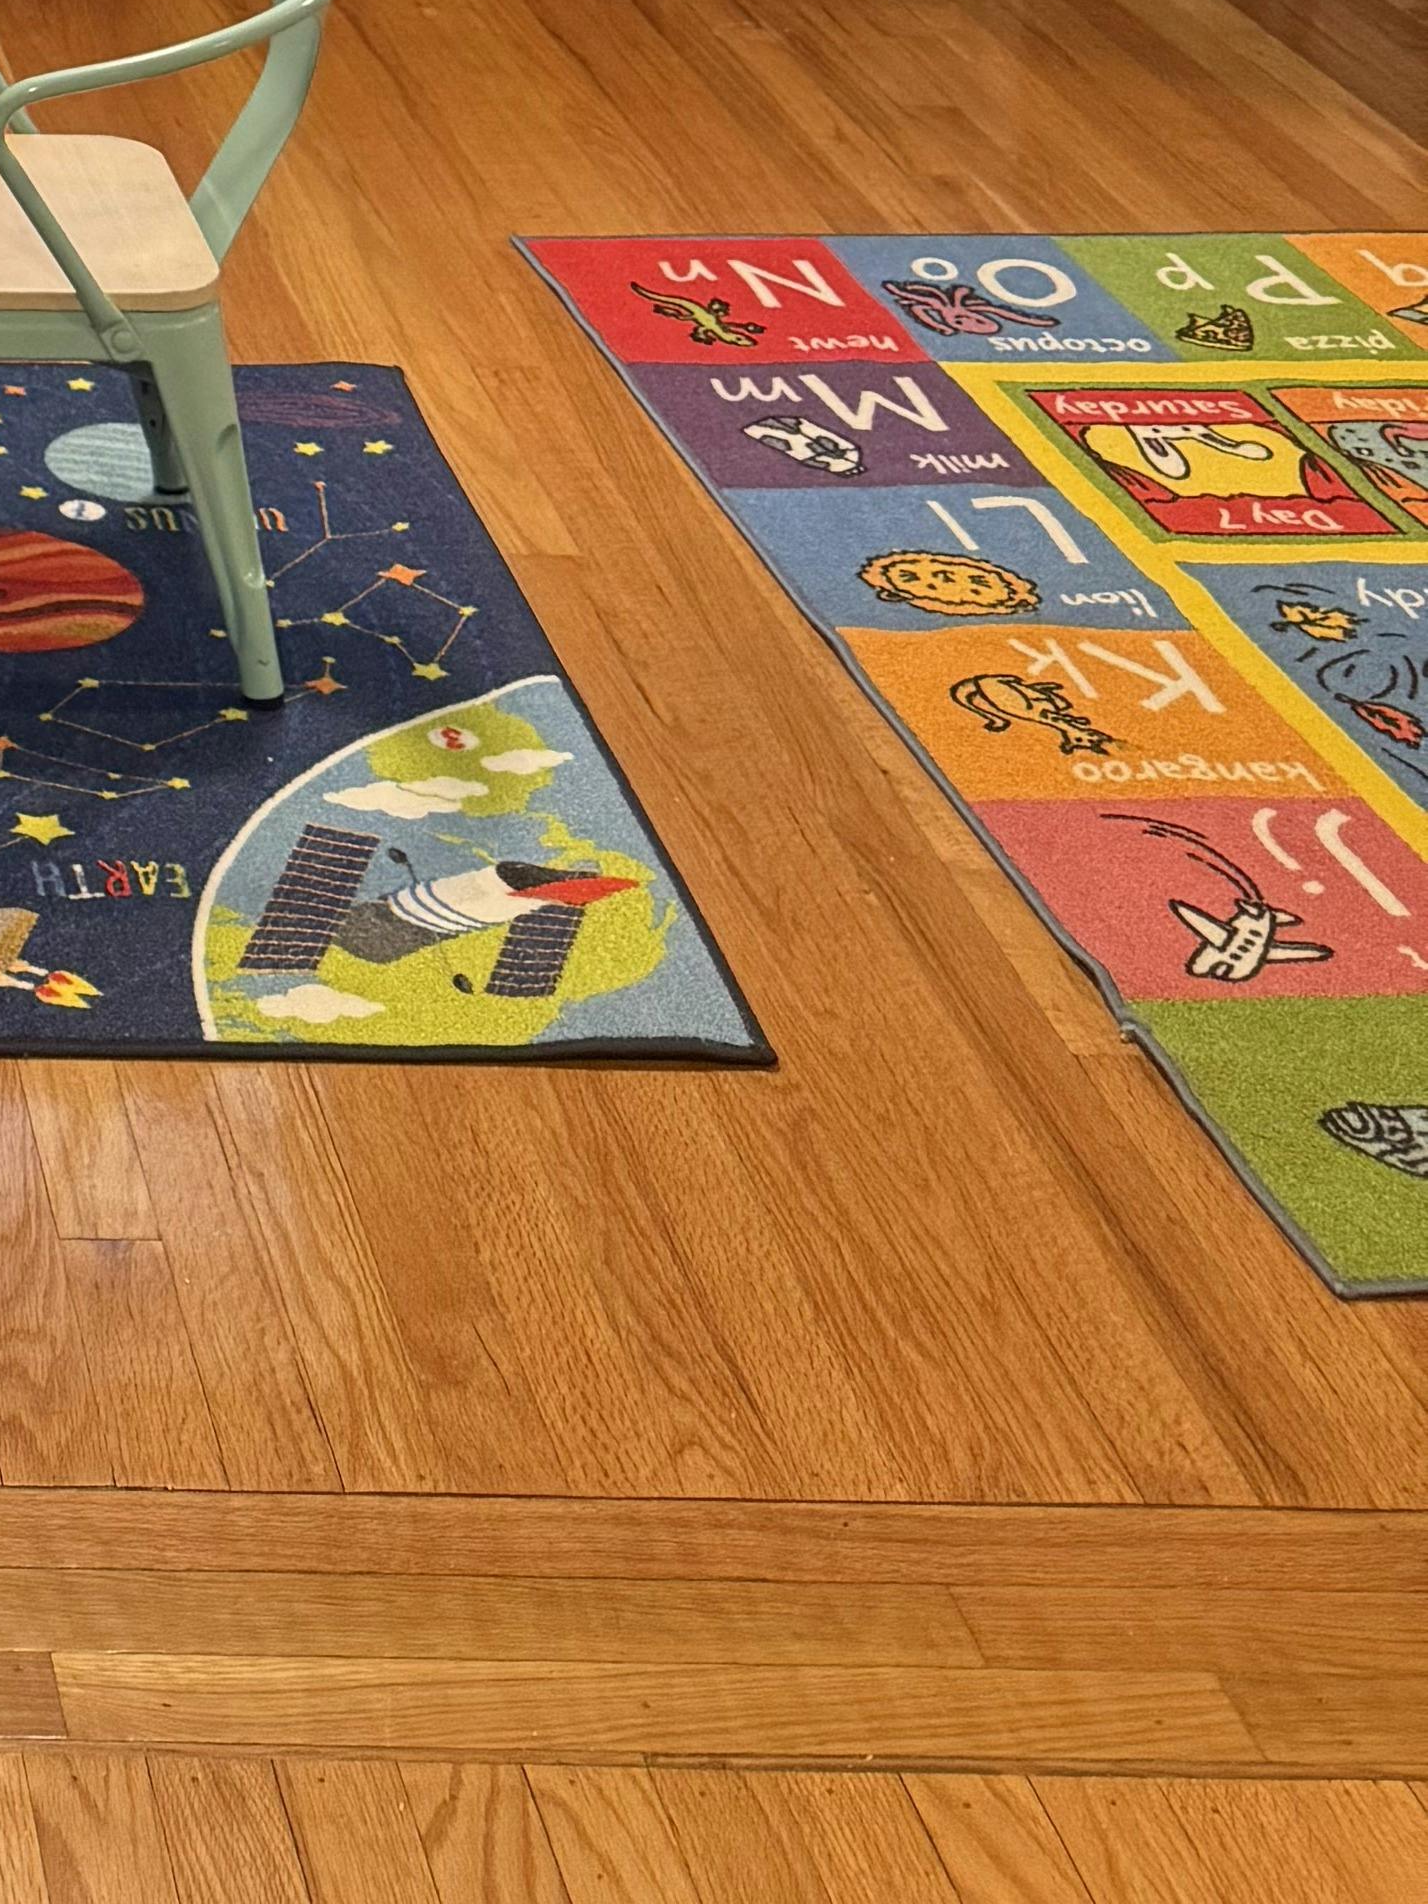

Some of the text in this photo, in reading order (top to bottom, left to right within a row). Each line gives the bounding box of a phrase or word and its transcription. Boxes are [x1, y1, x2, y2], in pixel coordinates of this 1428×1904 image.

[788, 334, 899, 354] newt
[987, 332, 1151, 353] octopus
[1284, 329, 1396, 355] pizza
[1054, 394, 1253, 421] Saturday
[910, 452, 1010, 474] milk
[1218, 502, 1345, 531] Day 7
[1060, 588, 1158, 619] lion
[1071, 753, 1328, 794] kangaroo
[31, 859, 191, 901] EARTH
